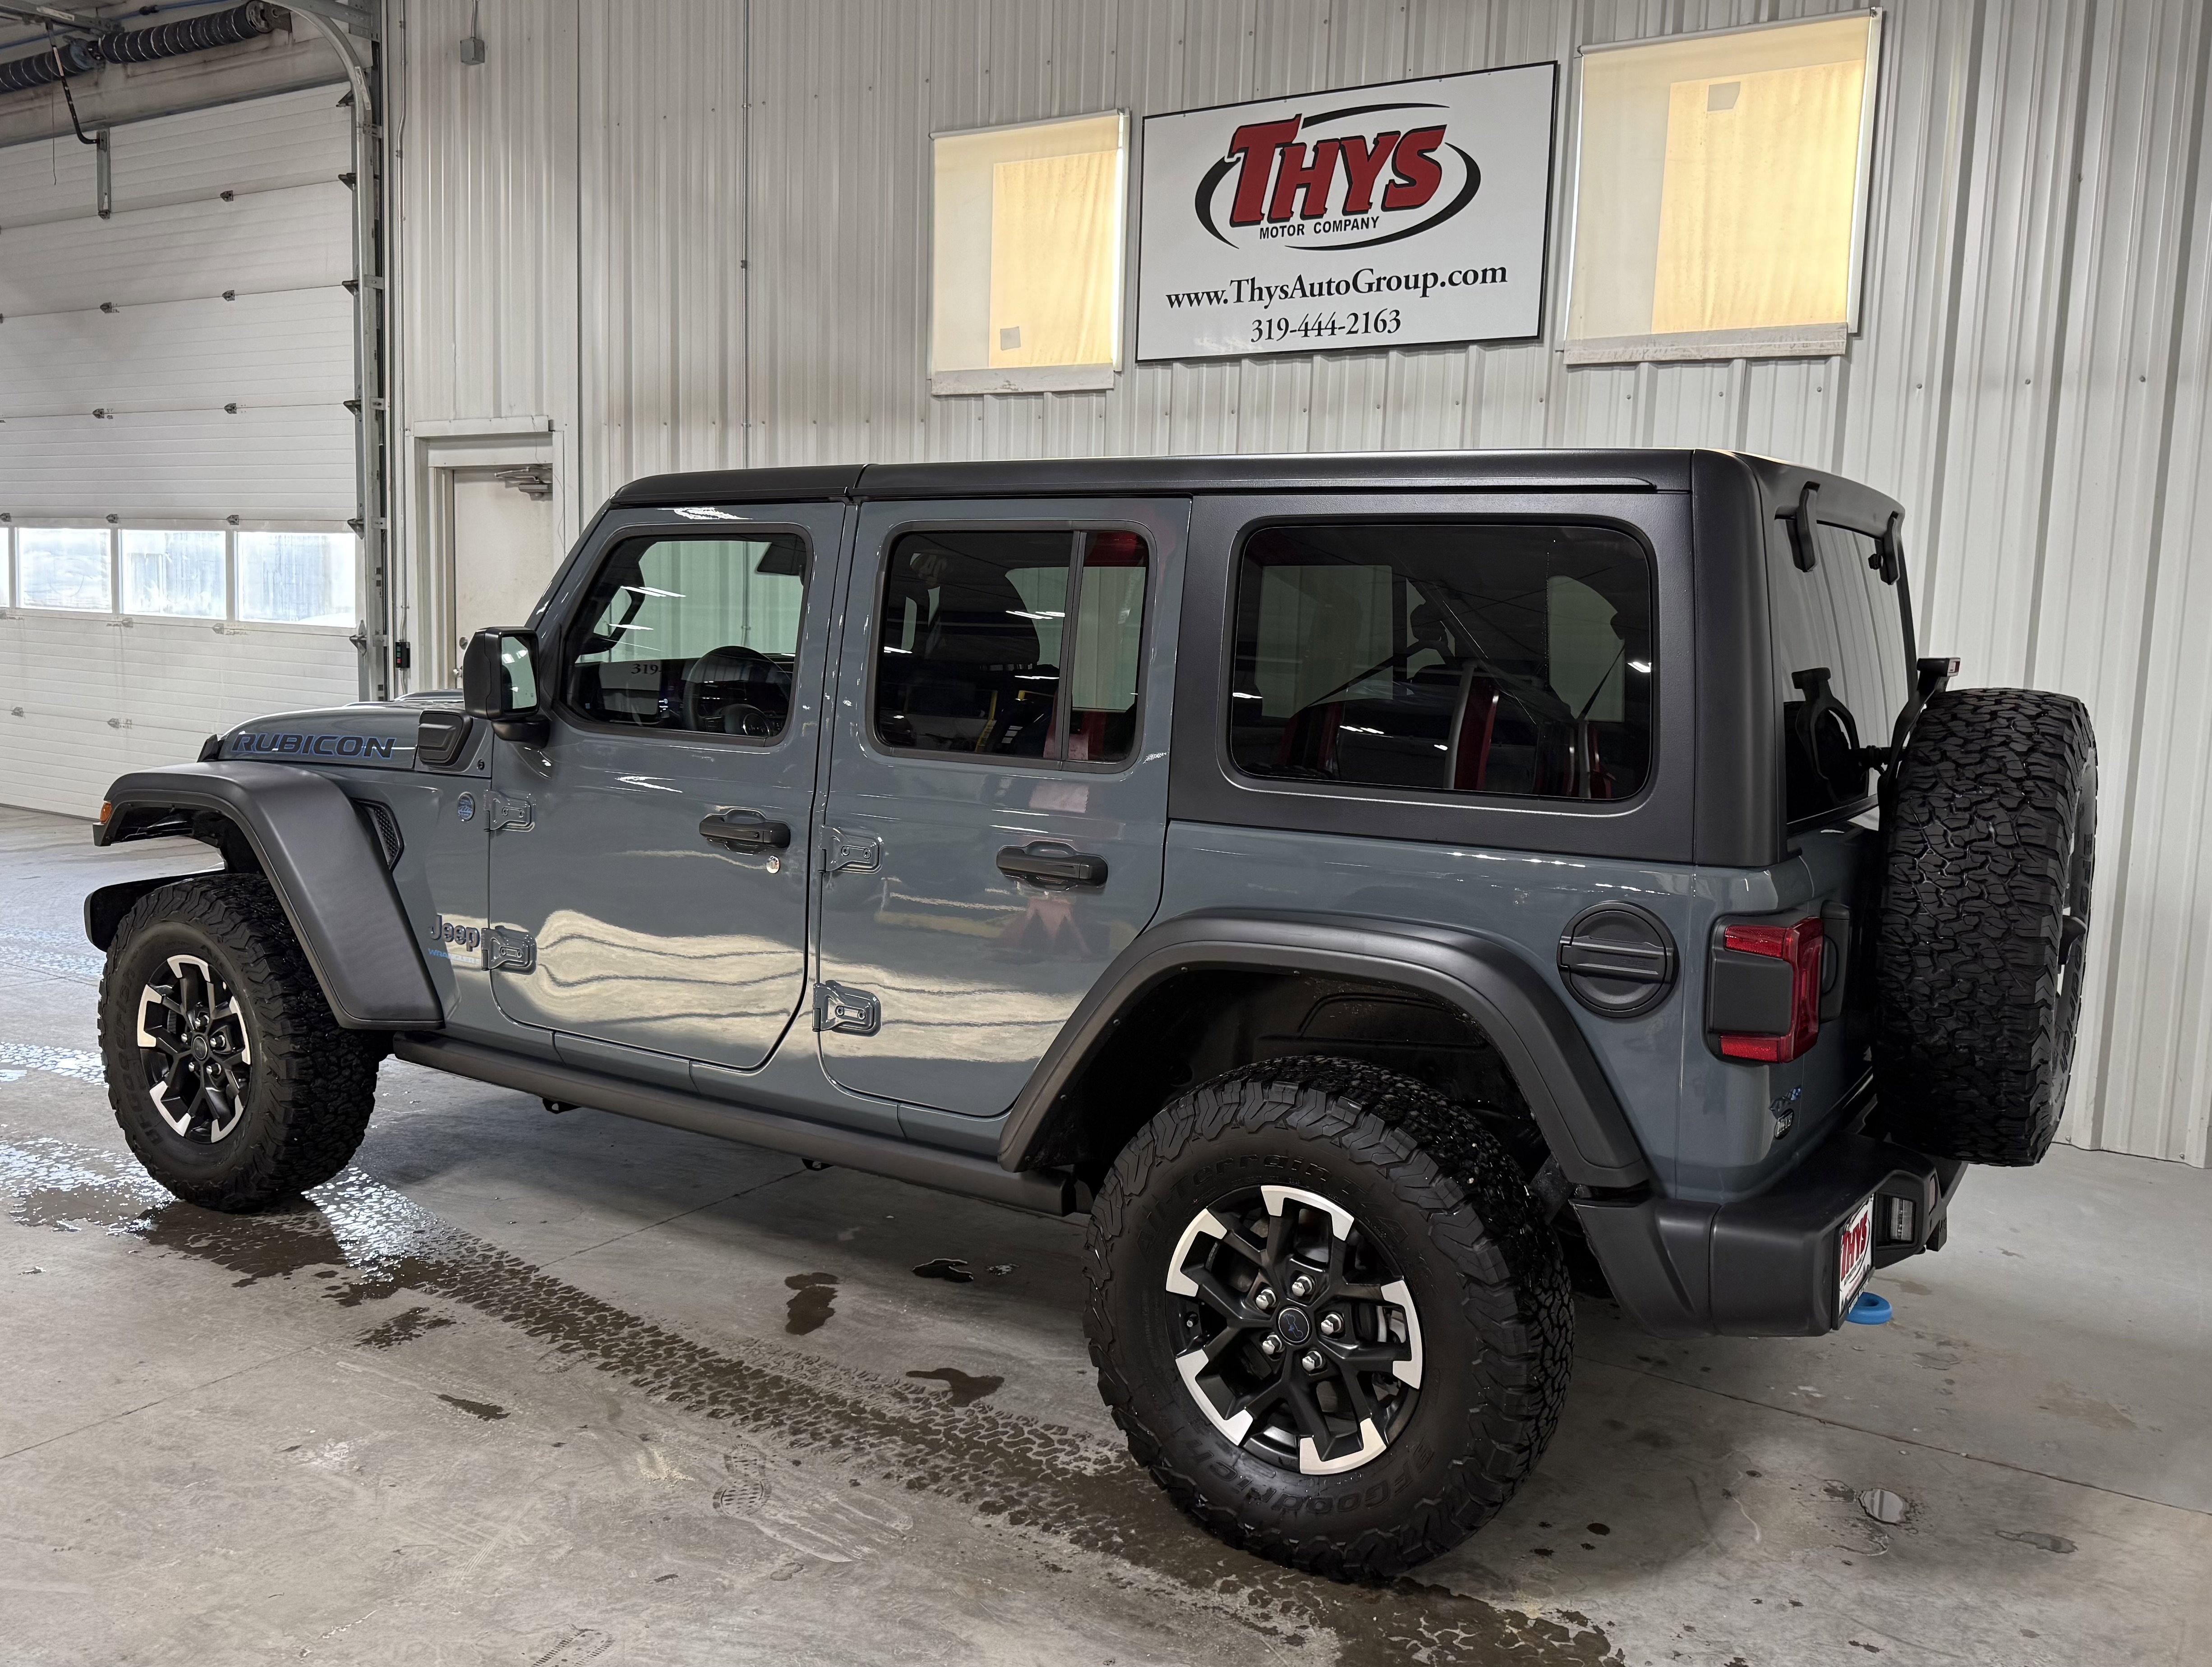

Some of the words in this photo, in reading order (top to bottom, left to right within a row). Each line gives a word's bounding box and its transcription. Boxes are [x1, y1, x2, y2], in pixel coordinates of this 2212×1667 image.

[1227, 113, 1447, 228] THYS
[1259, 223, 1305, 240] MOTOR
[1313, 216, 1380, 234] COMPANY
[1166, 267, 1508, 309] www.ThysAutoGroup.com
[1250, 309, 1401, 343] 319-444-2163
[231, 732, 397, 760] RUBICON
[428, 913, 480, 952] Jeep
[1841, 1210, 1868, 1282] THYS
